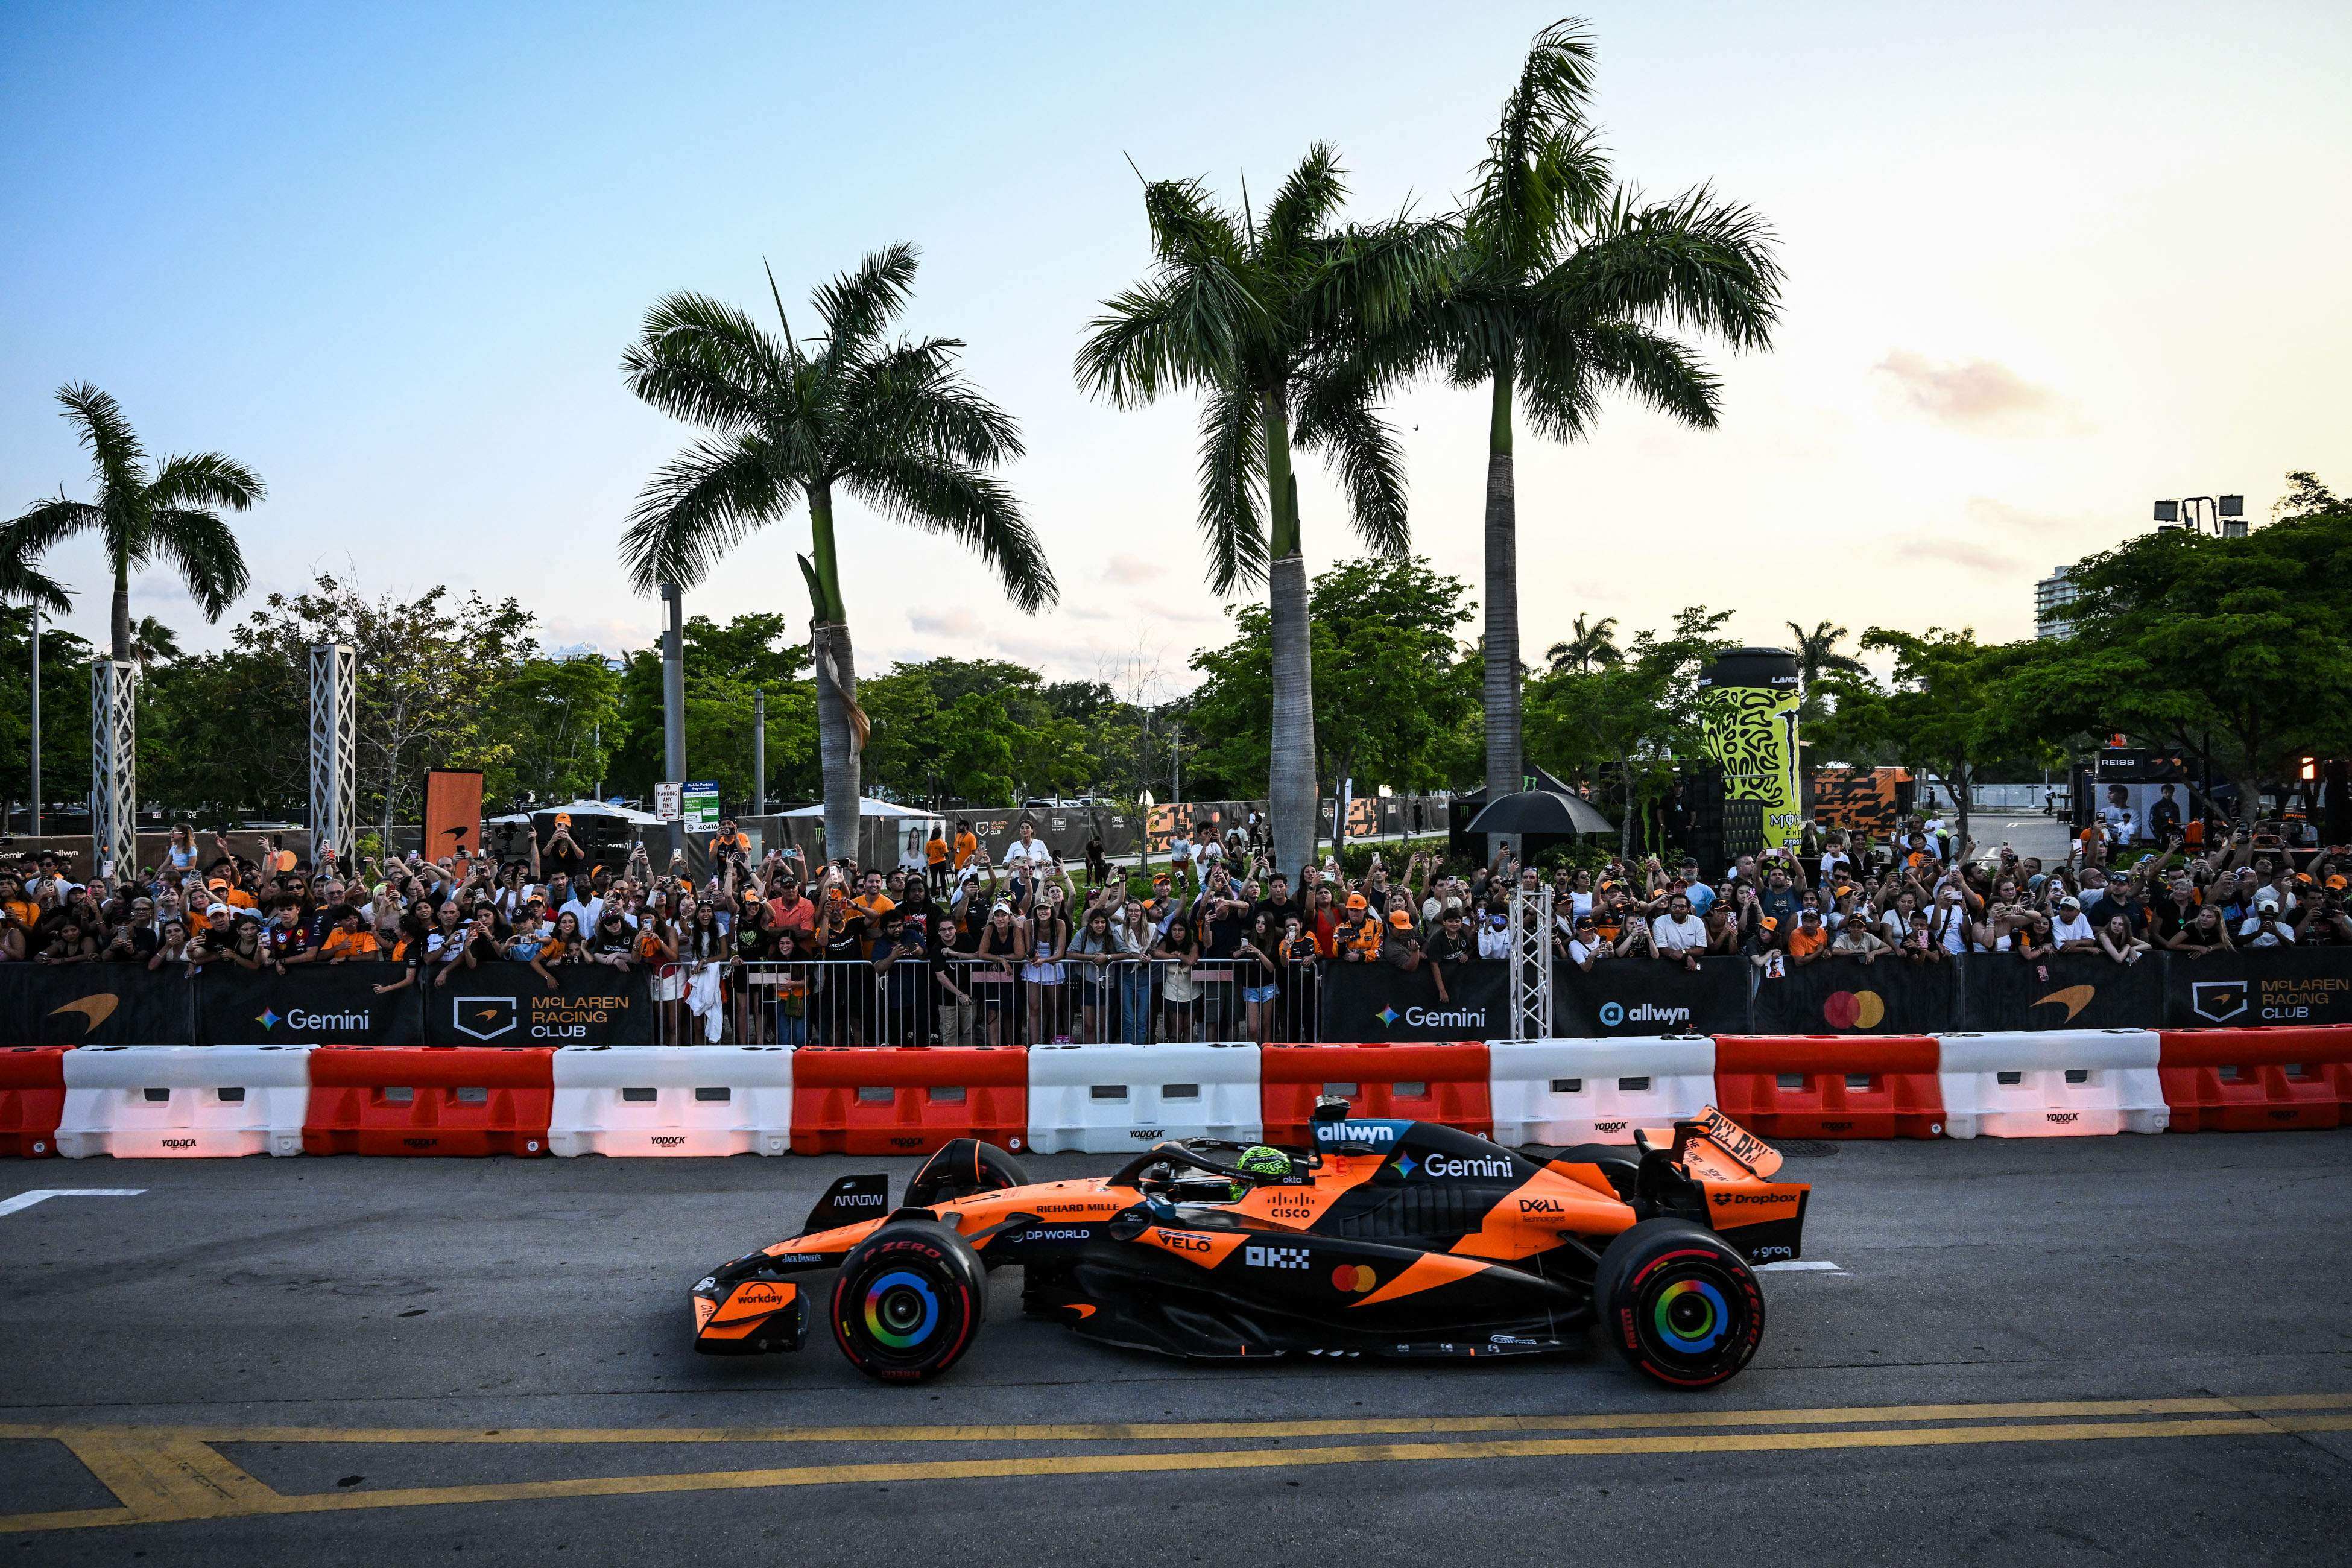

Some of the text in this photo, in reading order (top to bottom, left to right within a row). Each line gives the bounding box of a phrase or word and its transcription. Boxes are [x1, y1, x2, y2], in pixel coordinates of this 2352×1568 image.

[2262, 980, 2349, 990] McLAREN
[532, 997, 628, 1008] McLAREN
[2262, 993, 2328, 1005] RACING
[532, 1011, 607, 1023] RACING
[1406, 1007, 1485, 1028] Gemini
[1628, 1003, 1689, 1025] allwyn
[2262, 1007, 2309, 1019] CLUB
[288, 1009, 369, 1030] Gemini
[531, 1026, 586, 1038] CLUB
[1130, 1130, 1163, 1138] YODOCK
[1317, 1122, 1393, 1143] allwyn
[1336, 1158, 1347, 1173] E
[1424, 1154, 1513, 1177] Gemini
[834, 1194, 883, 1206] ARROW
[1519, 1199, 1564, 1212] DELL
[1734, 1193, 1797, 1206] Dropbox
[1037, 1204, 1084, 1213] RICHARD
[1272, 1209, 1310, 1218] CISCO
[1026, 1230, 1090, 1240] DP WORLD
[1159, 1234, 1212, 1253] VELO
[864, 1241, 941, 1262] P ZERO
[1761, 1245, 1791, 1257] groq
[782, 1254, 821, 1263] JACK DANIEL'S
[1246, 1246, 1309, 1269] OKX
[738, 1294, 783, 1305] workday
[1731, 1268, 1760, 1344] P ZERO
